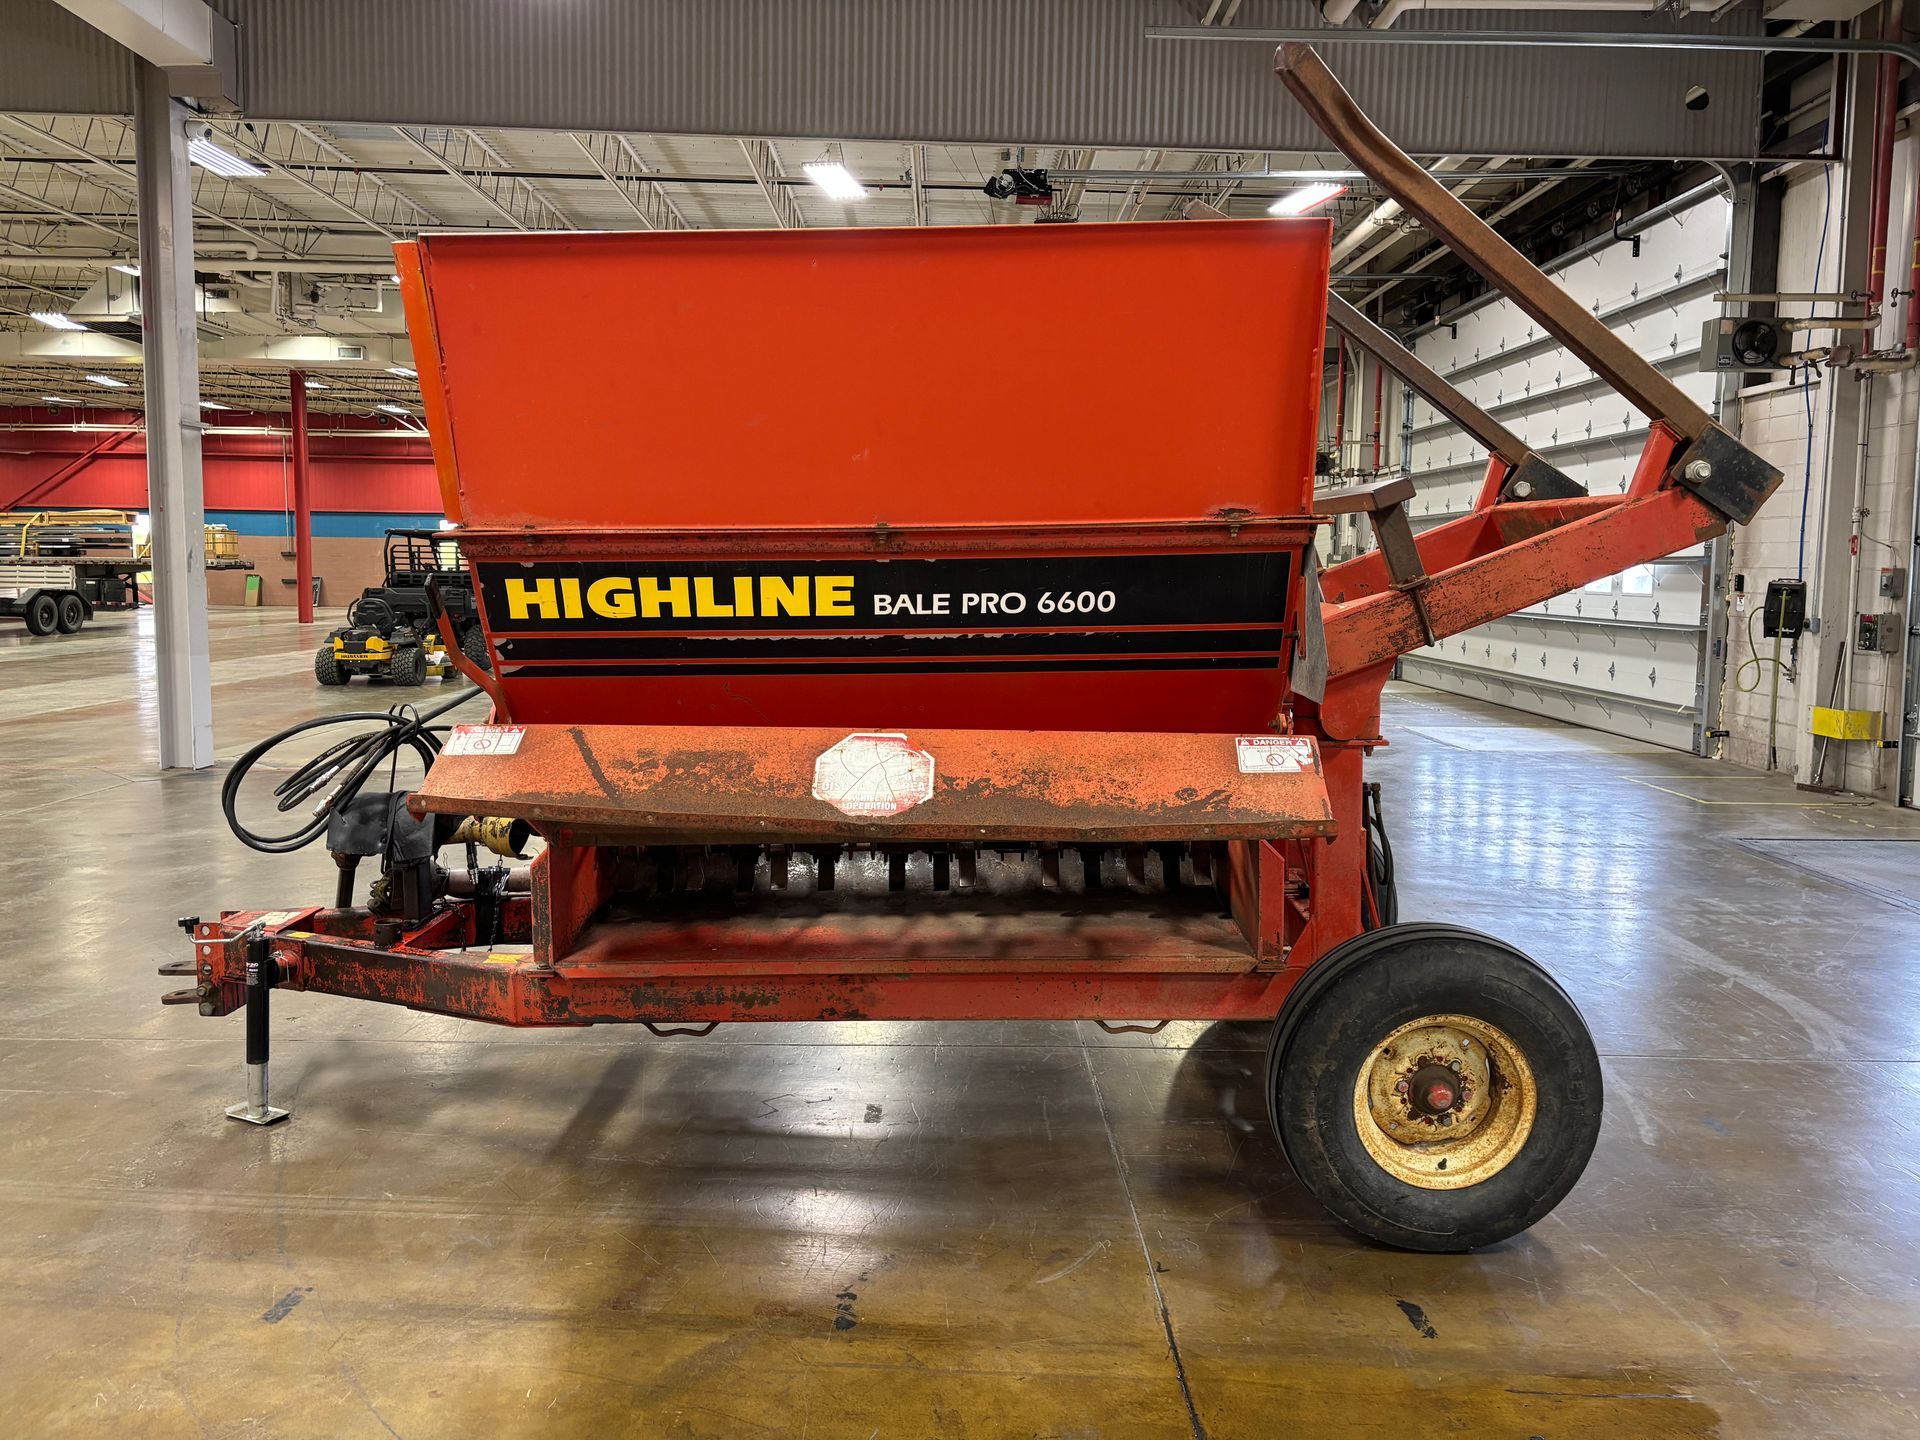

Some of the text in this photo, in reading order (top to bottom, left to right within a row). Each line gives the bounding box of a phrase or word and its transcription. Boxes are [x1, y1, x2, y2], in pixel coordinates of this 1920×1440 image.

[504, 575, 1117, 620] HIGHLINE BALE PRO 6600
[847, 801, 897, 811] OPERATION
